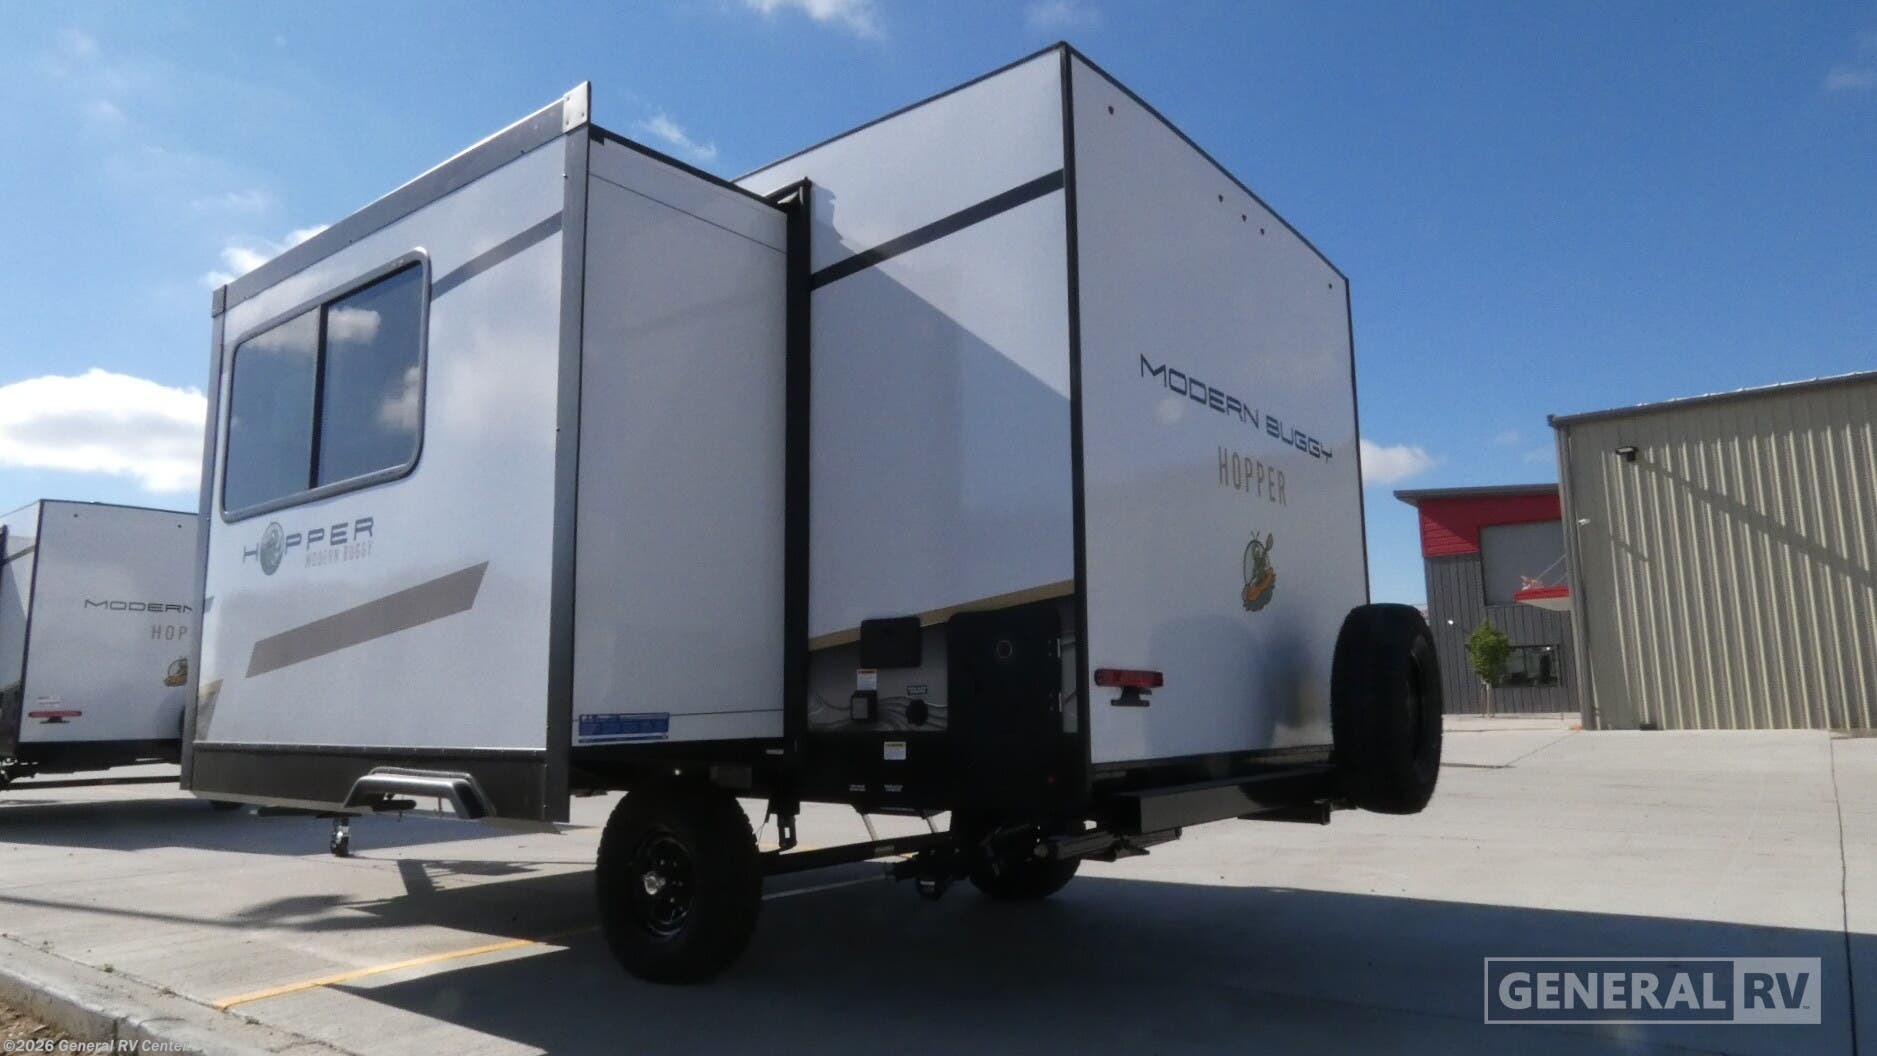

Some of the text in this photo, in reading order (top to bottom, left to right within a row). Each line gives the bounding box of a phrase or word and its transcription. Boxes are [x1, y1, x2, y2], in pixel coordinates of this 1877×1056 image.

[1140, 353, 1333, 463] MODERN BUGGY
[1217, 446, 1288, 507] HOPPER
[304, 540, 374, 569] MODERN BUGGY
